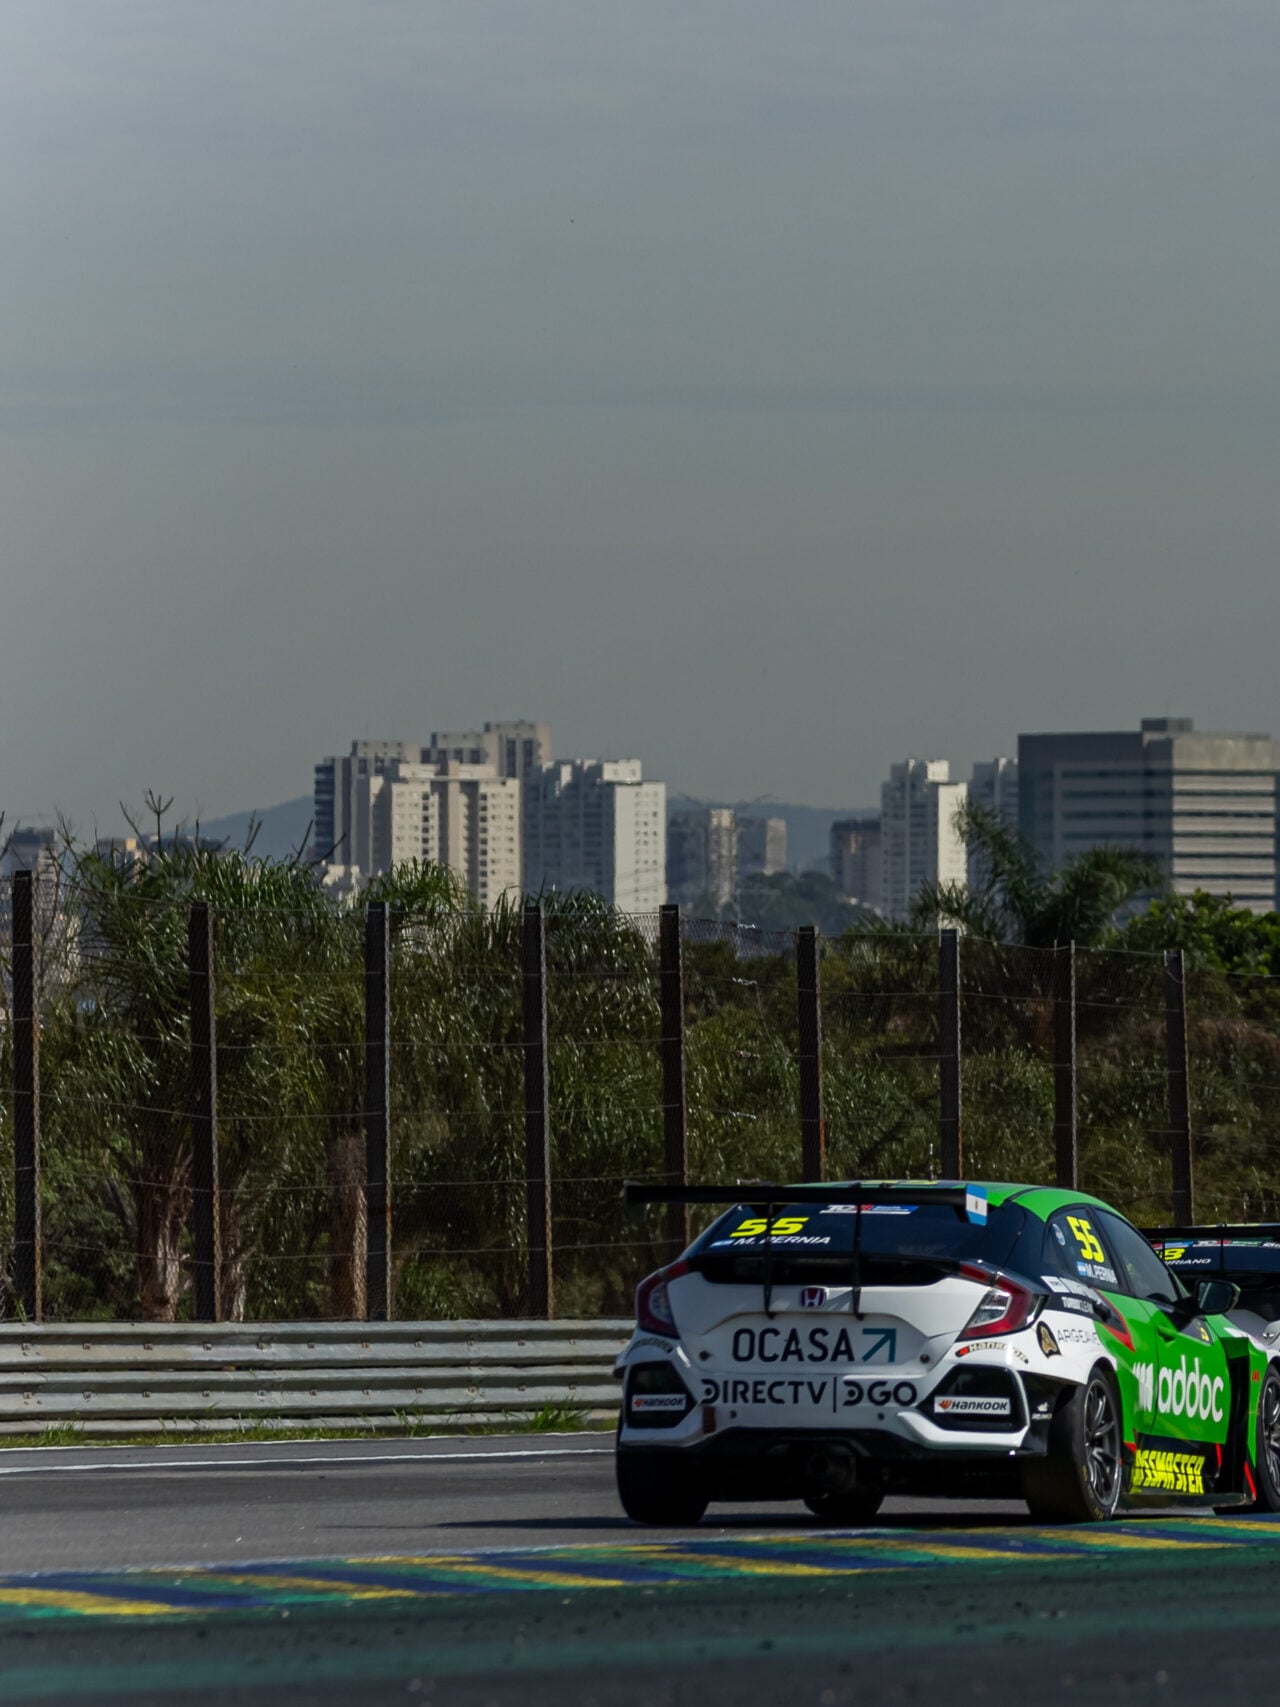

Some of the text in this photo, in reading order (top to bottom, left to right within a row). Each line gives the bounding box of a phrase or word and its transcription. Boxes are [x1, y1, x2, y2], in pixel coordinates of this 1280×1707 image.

[729, 1216, 810, 1238] 55
[1066, 1216, 1105, 1263] 55
[762, 1235, 831, 1245] PERNIA
[1155, 1247, 1186, 1261] 8
[732, 1327, 855, 1363] OCASA
[700, 1378, 918, 1407] DIRECTV DGO
